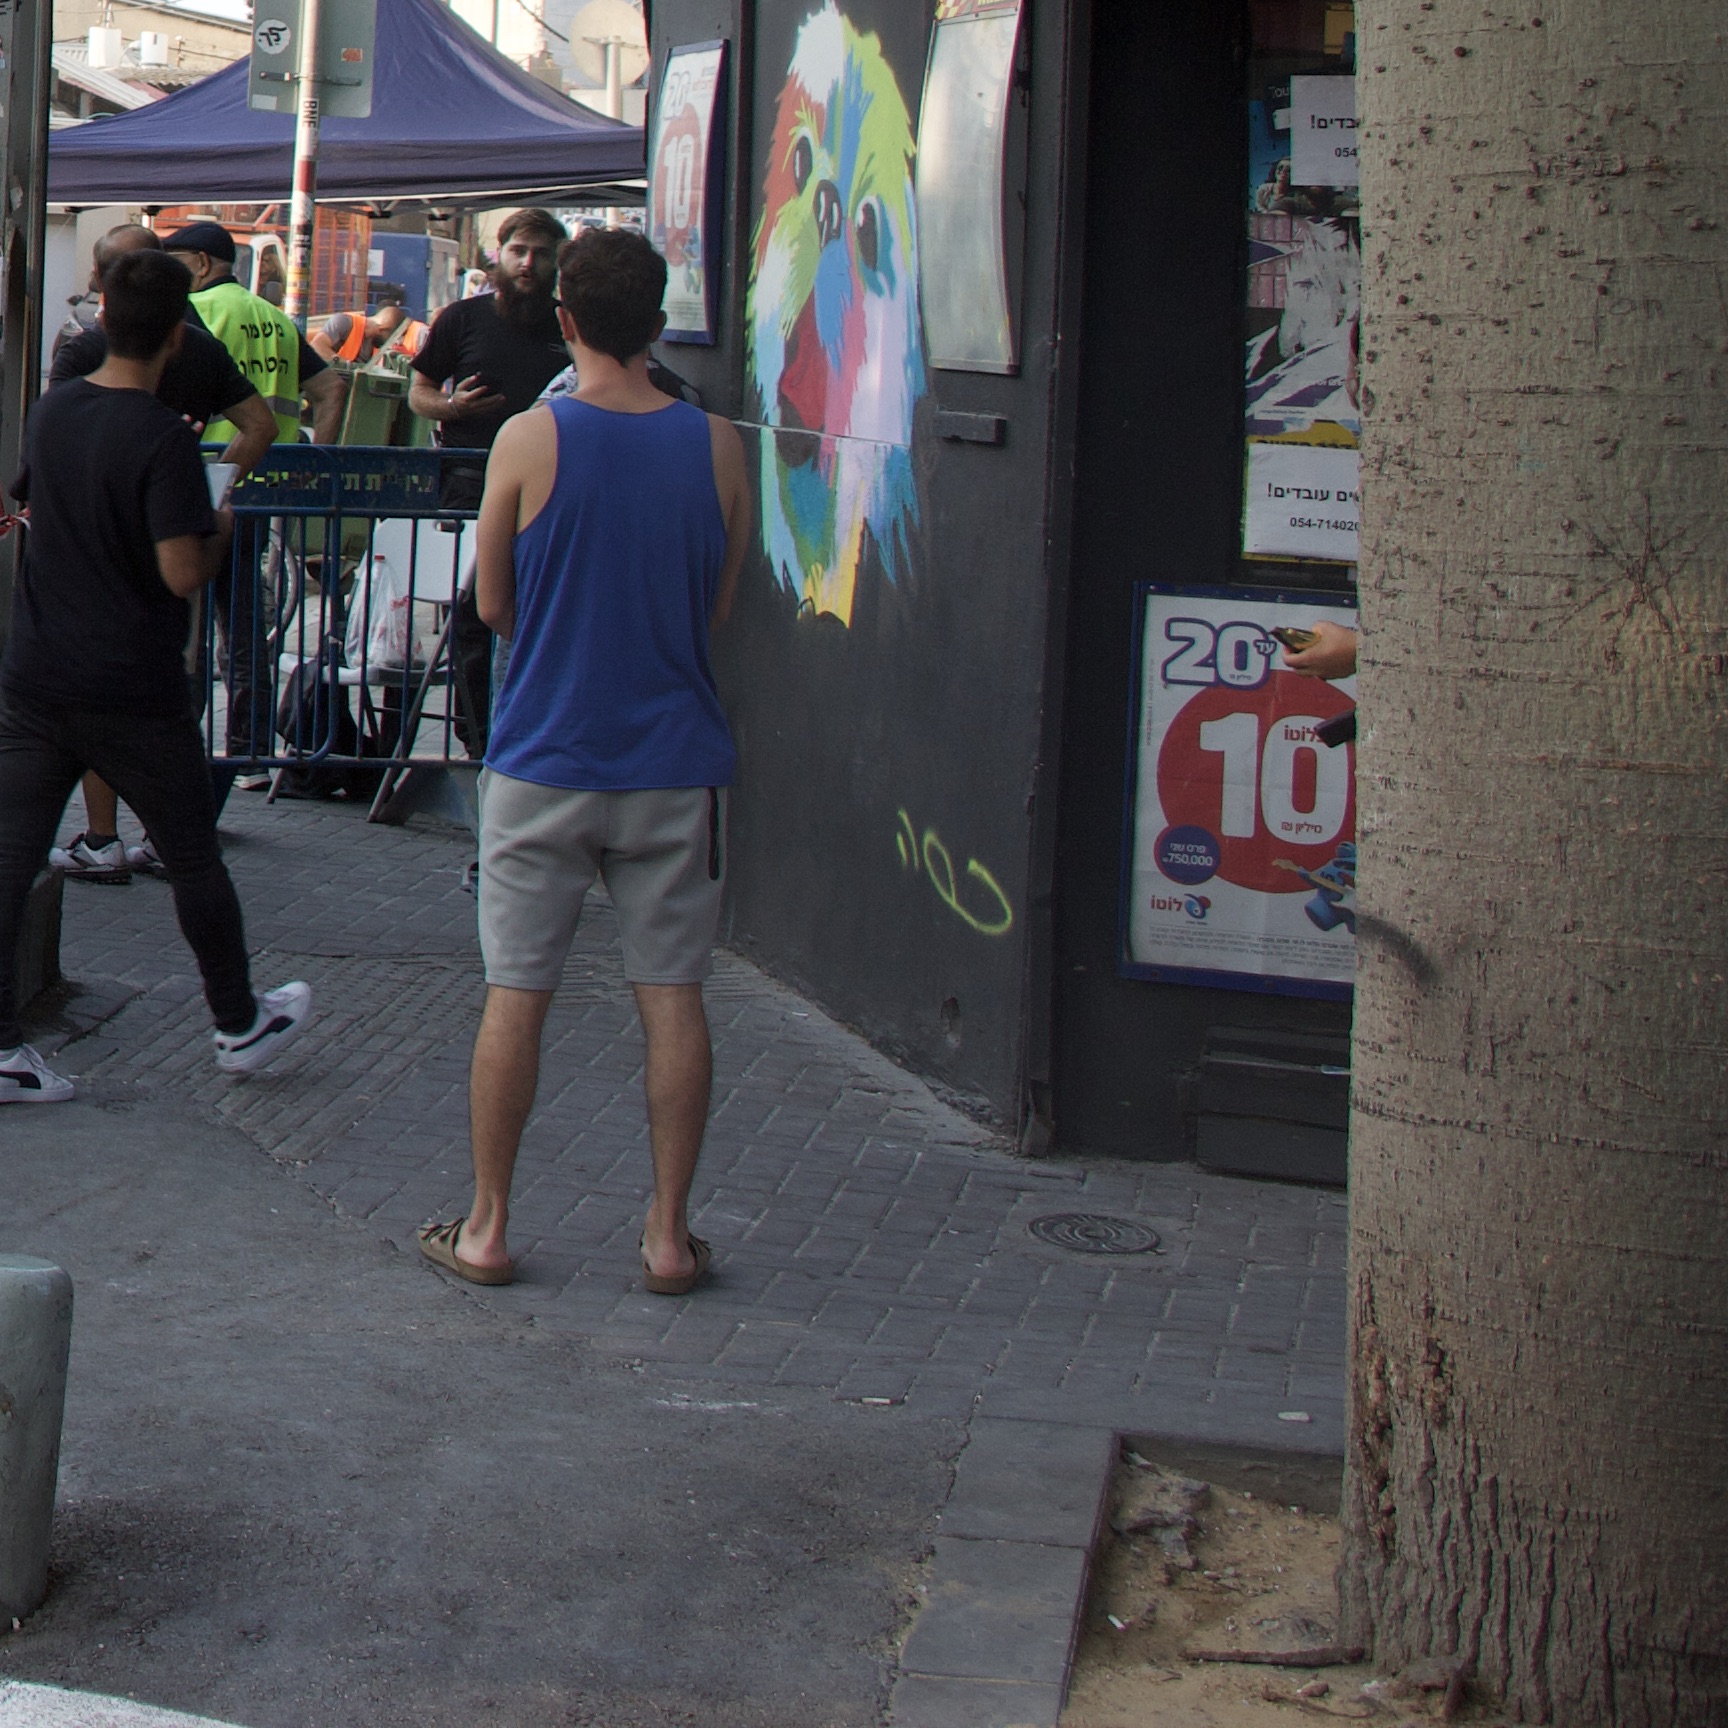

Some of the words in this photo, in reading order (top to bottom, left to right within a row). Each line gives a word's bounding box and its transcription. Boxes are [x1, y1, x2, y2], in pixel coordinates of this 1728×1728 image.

[663, 133, 694, 229] 10
[240, 321, 285, 339] משמר
[1267, 483, 1330, 503] עובדים!
[1161, 616, 1271, 692] 20
[1255, 640, 1276, 655] עד
[1284, 725, 1324, 743] לוטו
[1200, 712, 1349, 845] 10
[1294, 822, 1322, 835] מיליון
[1187, 844, 1206, 854] פרס
[1168, 853, 1213, 866] 750,000
[1150, 895, 1183, 912] לוטו
